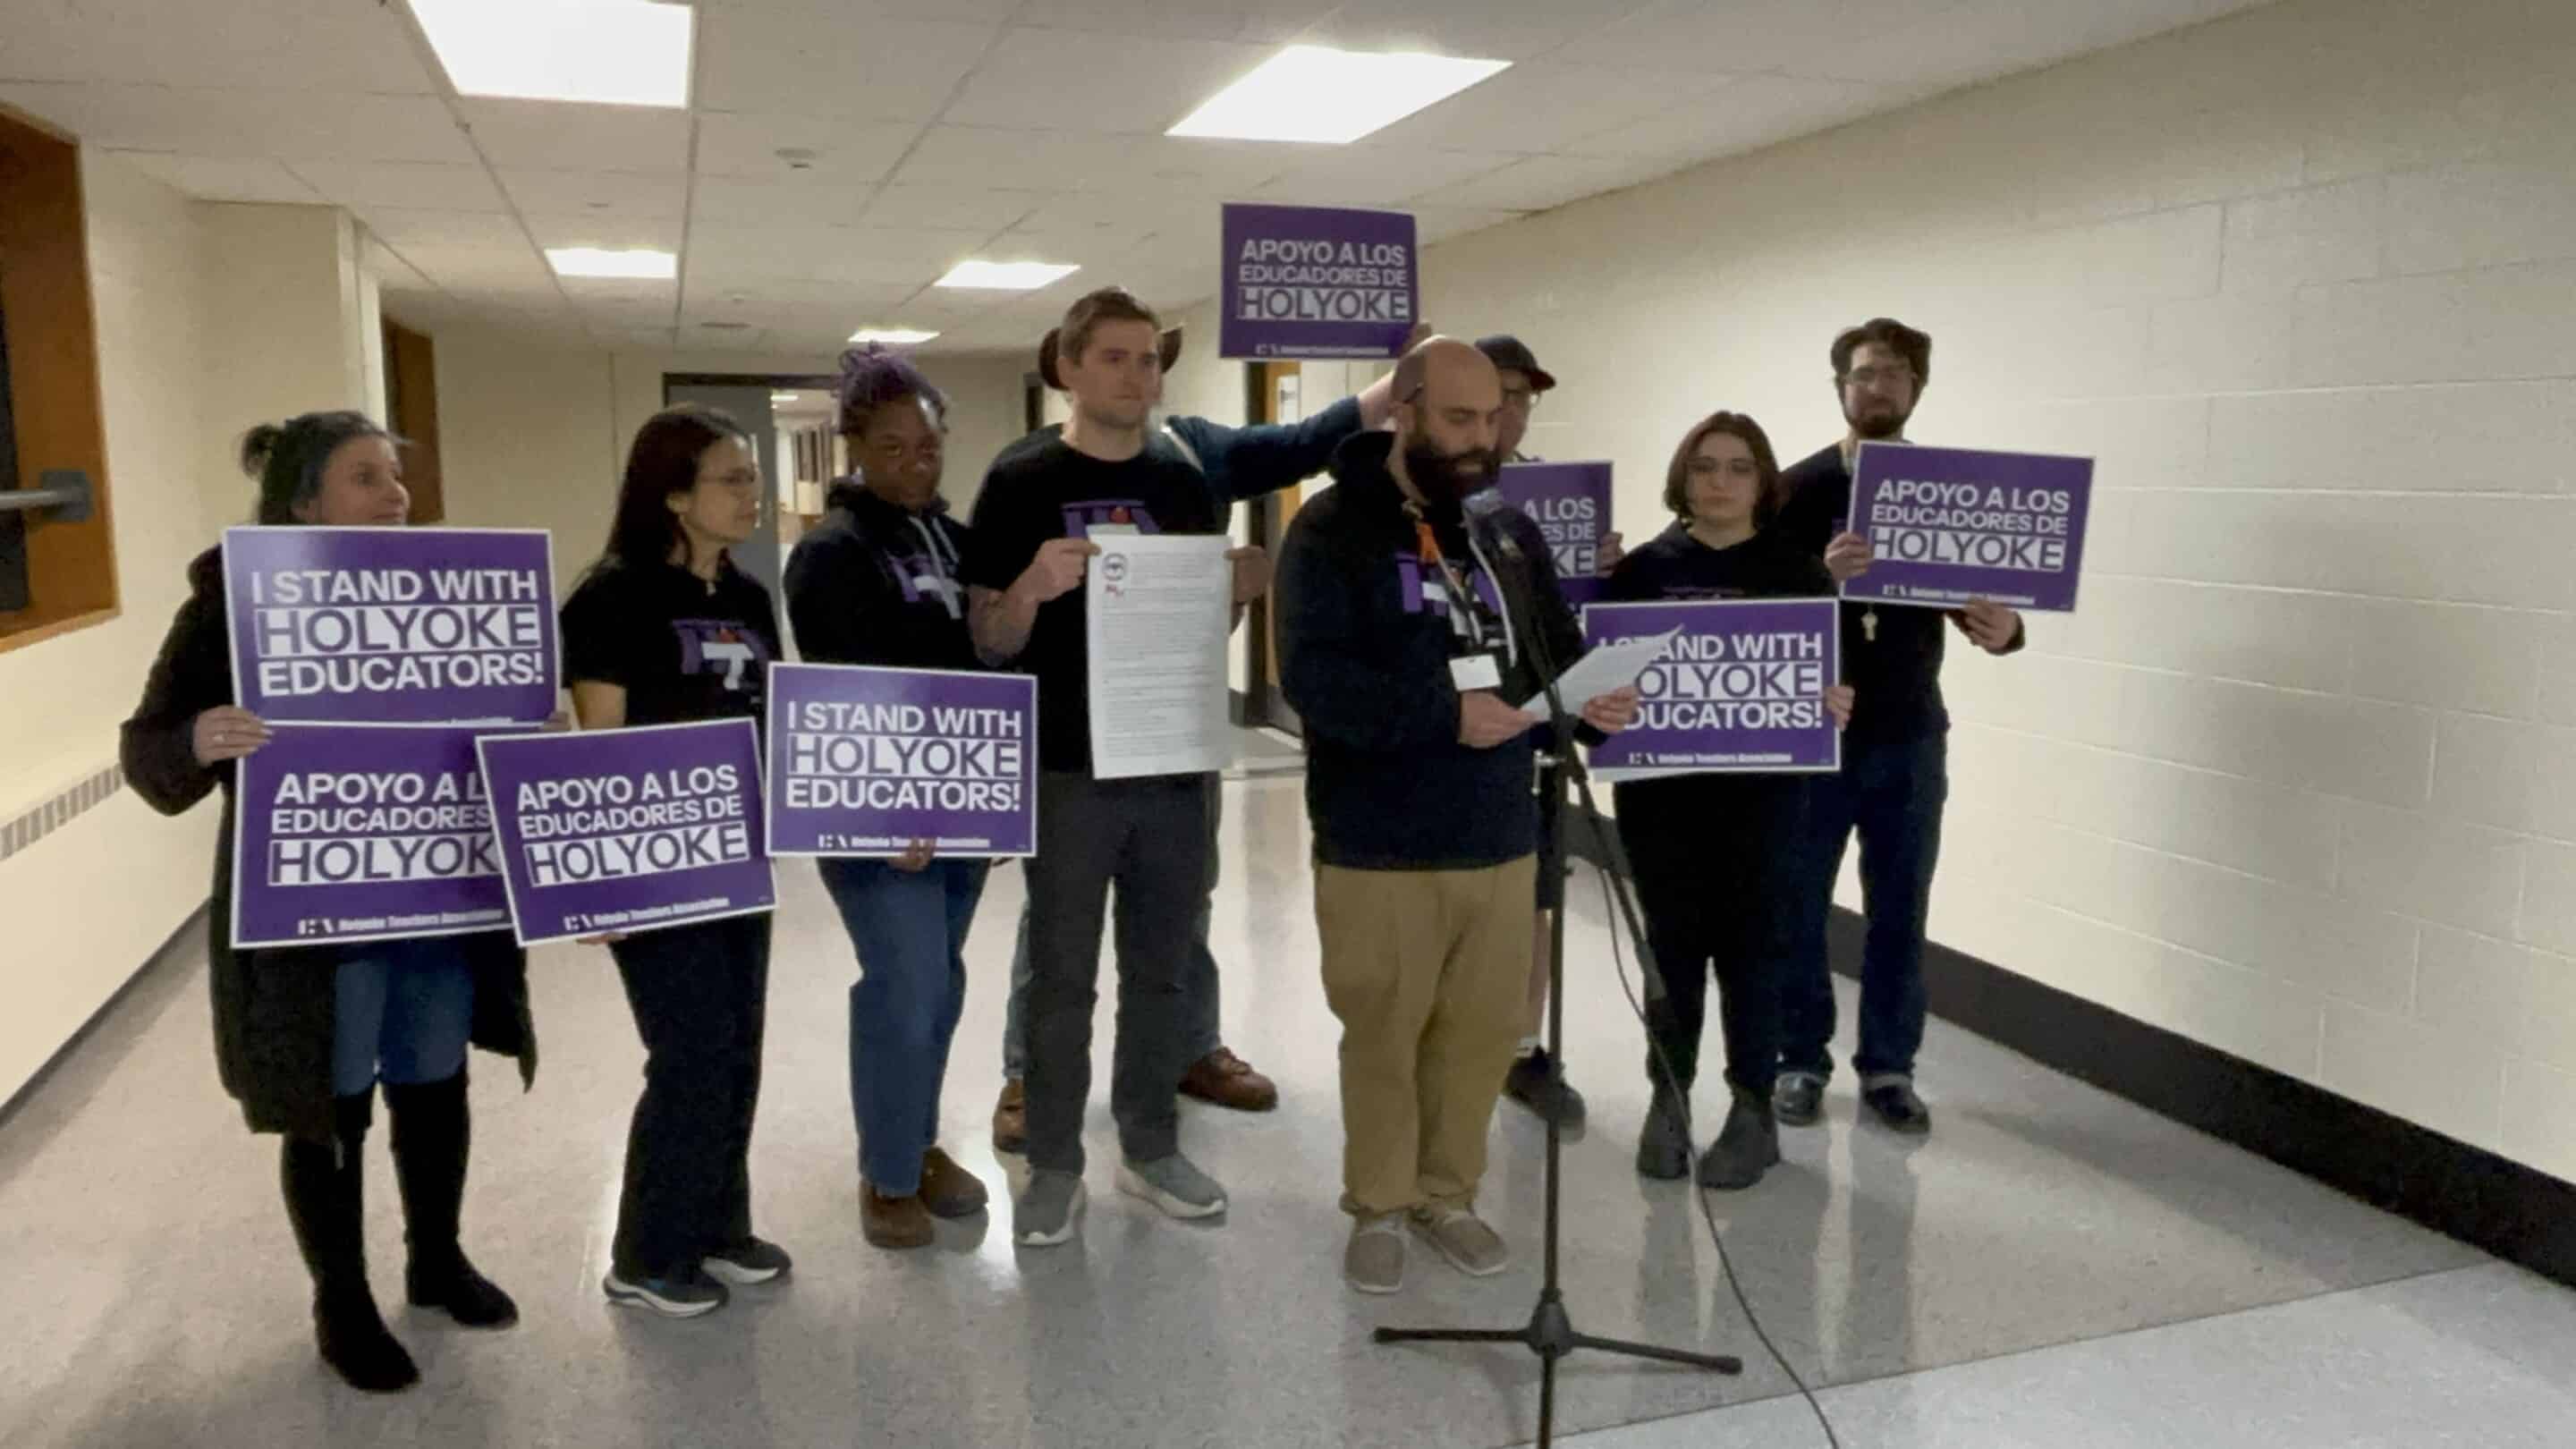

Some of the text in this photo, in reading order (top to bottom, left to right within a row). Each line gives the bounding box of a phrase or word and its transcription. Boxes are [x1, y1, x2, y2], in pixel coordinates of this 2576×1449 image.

[1241, 239, 1405, 267] APOYO A LOS
[1239, 265, 1408, 287] EDUCADORES DE
[1239, 287, 1411, 320] HOLYOKE
[1545, 497, 1597, 521] LOS
[1875, 479, 2071, 513] APOYO A LOS
[1568, 521, 1597, 541] DE
[1871, 504, 2068, 535] EDUCADORES DE
[1871, 526, 2065, 572] HOLYOKE
[252, 570, 538, 605] I STAND WITH
[257, 606, 540, 656] HOLYOKE
[1732, 632, 1823, 659] WITH
[258, 652, 544, 698] EDUCATORS!
[1635, 662, 1822, 699] OLYOKE
[787, 700, 1021, 737] I STAND WITH
[1623, 701, 1824, 730] DUCATORS!
[787, 733, 1021, 779] HOLYOKE
[275, 773, 425, 804] APOYO
[432, 773, 459, 802] A
[517, 775, 632, 811] APOYO
[641, 773, 664, 801] A
[670, 764, 739, 798] LOS
[786, 779, 1021, 811] EDUCATORS!
[272, 805, 492, 834] EDUCADORES
[519, 794, 743, 838] EDUCADORES DE
[270, 835, 502, 884] HOLYOK
[525, 821, 749, 886] HOLYOKE
